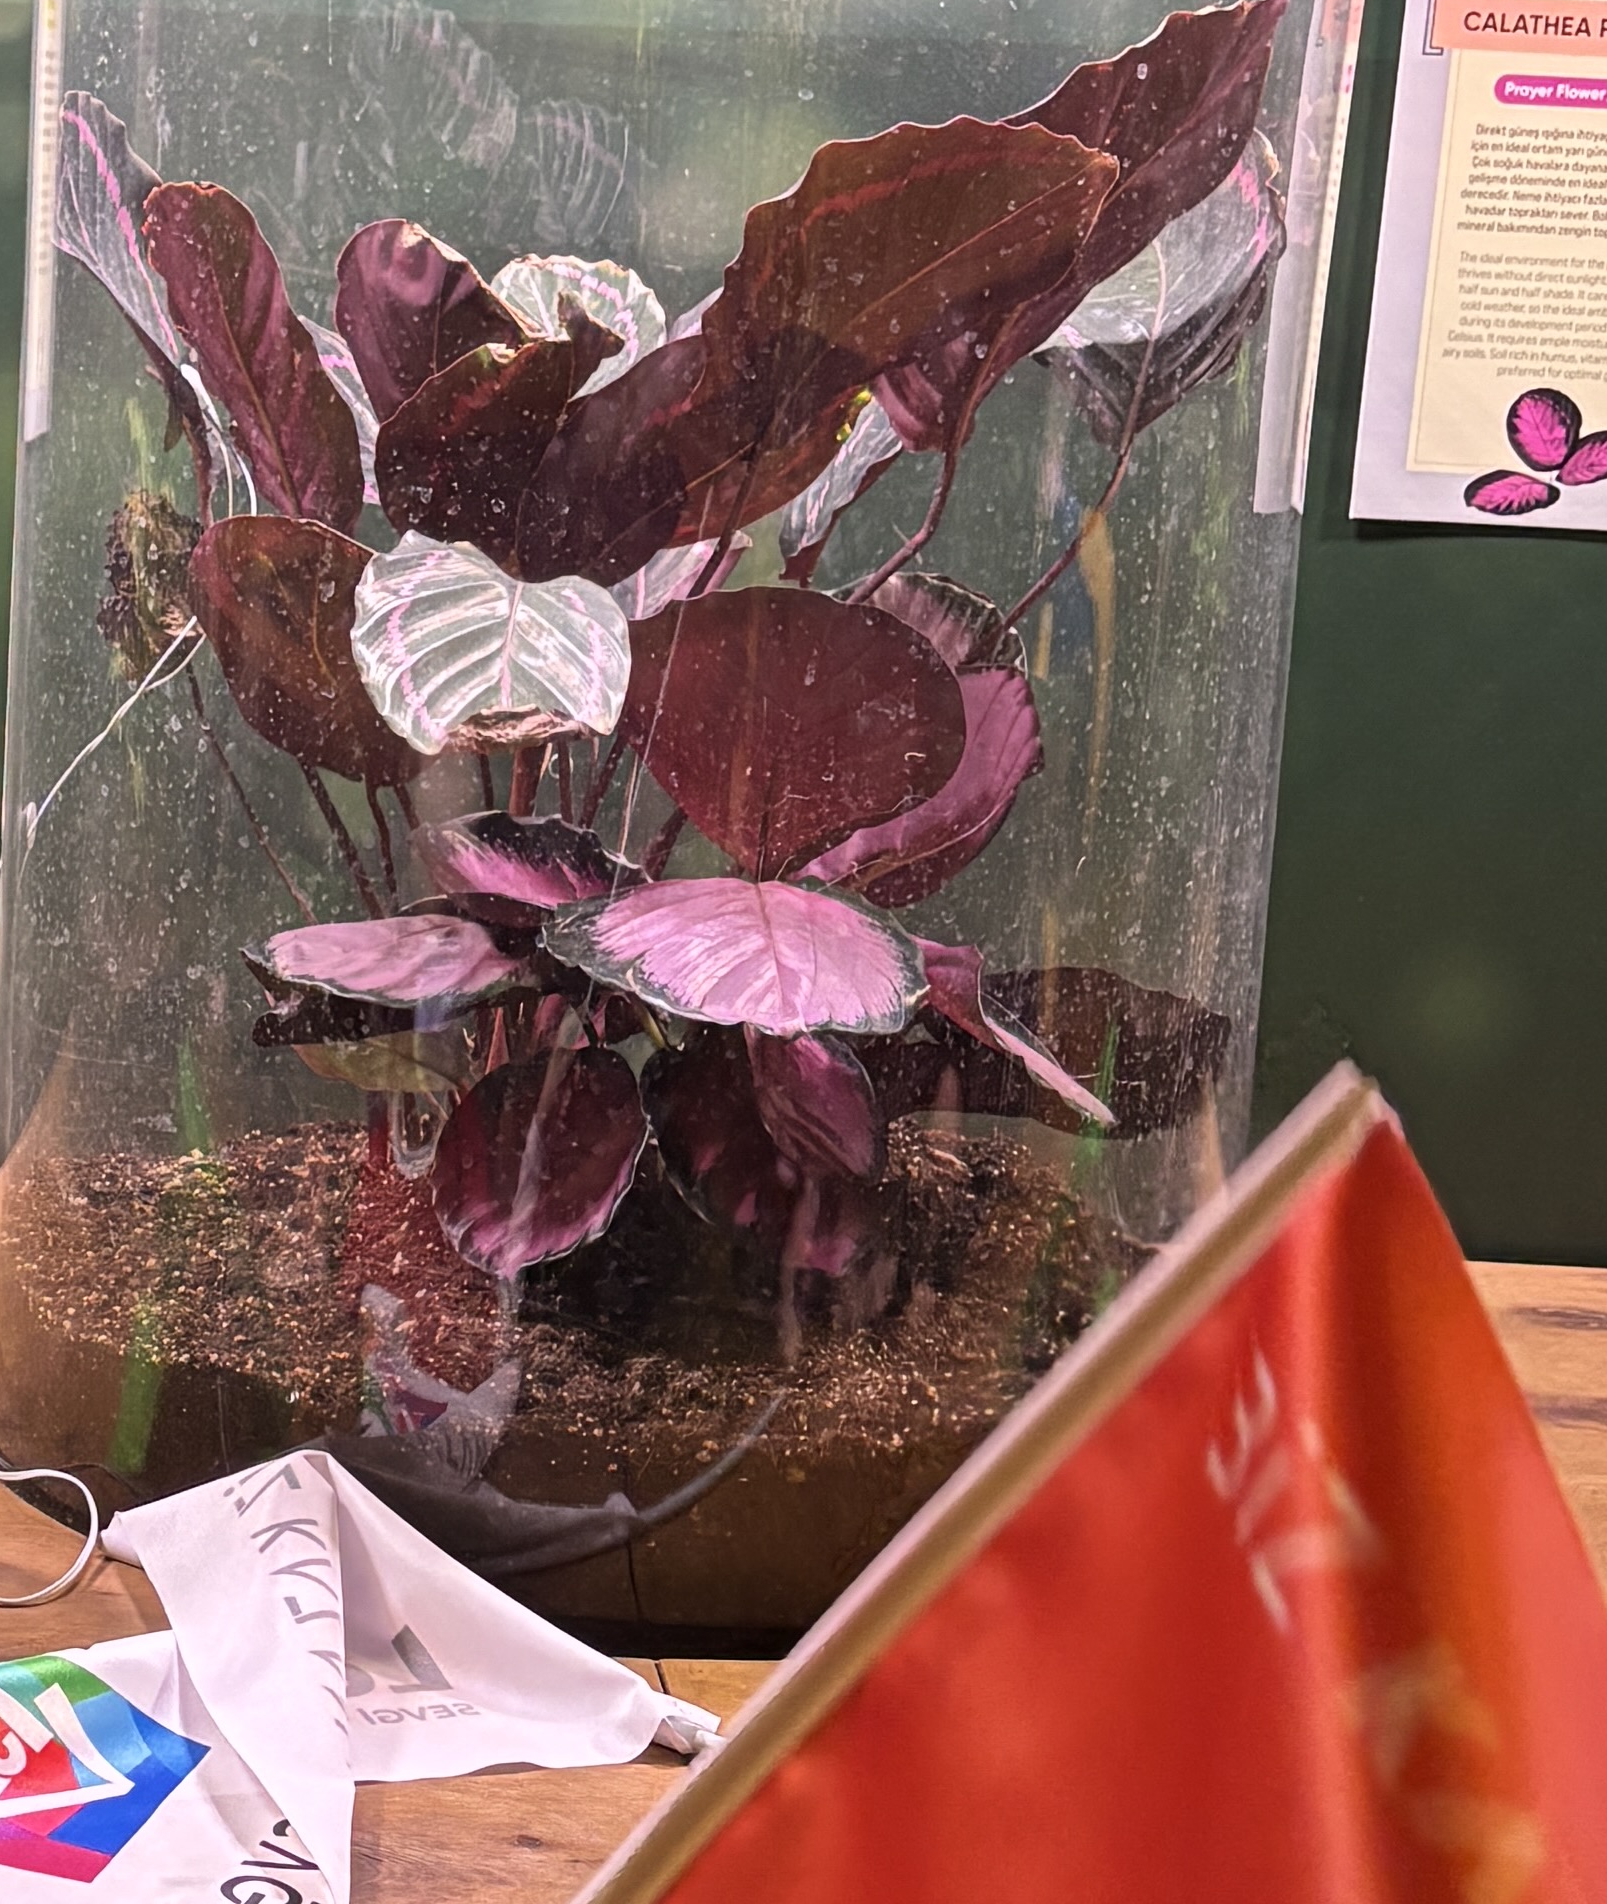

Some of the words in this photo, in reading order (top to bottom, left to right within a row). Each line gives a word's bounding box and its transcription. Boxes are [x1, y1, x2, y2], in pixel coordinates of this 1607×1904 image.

[1463, 10, 1592, 38] CALATHEA
[1504, 81, 1554, 100] Prayer
[1556, 83, 1607, 101] Flower
